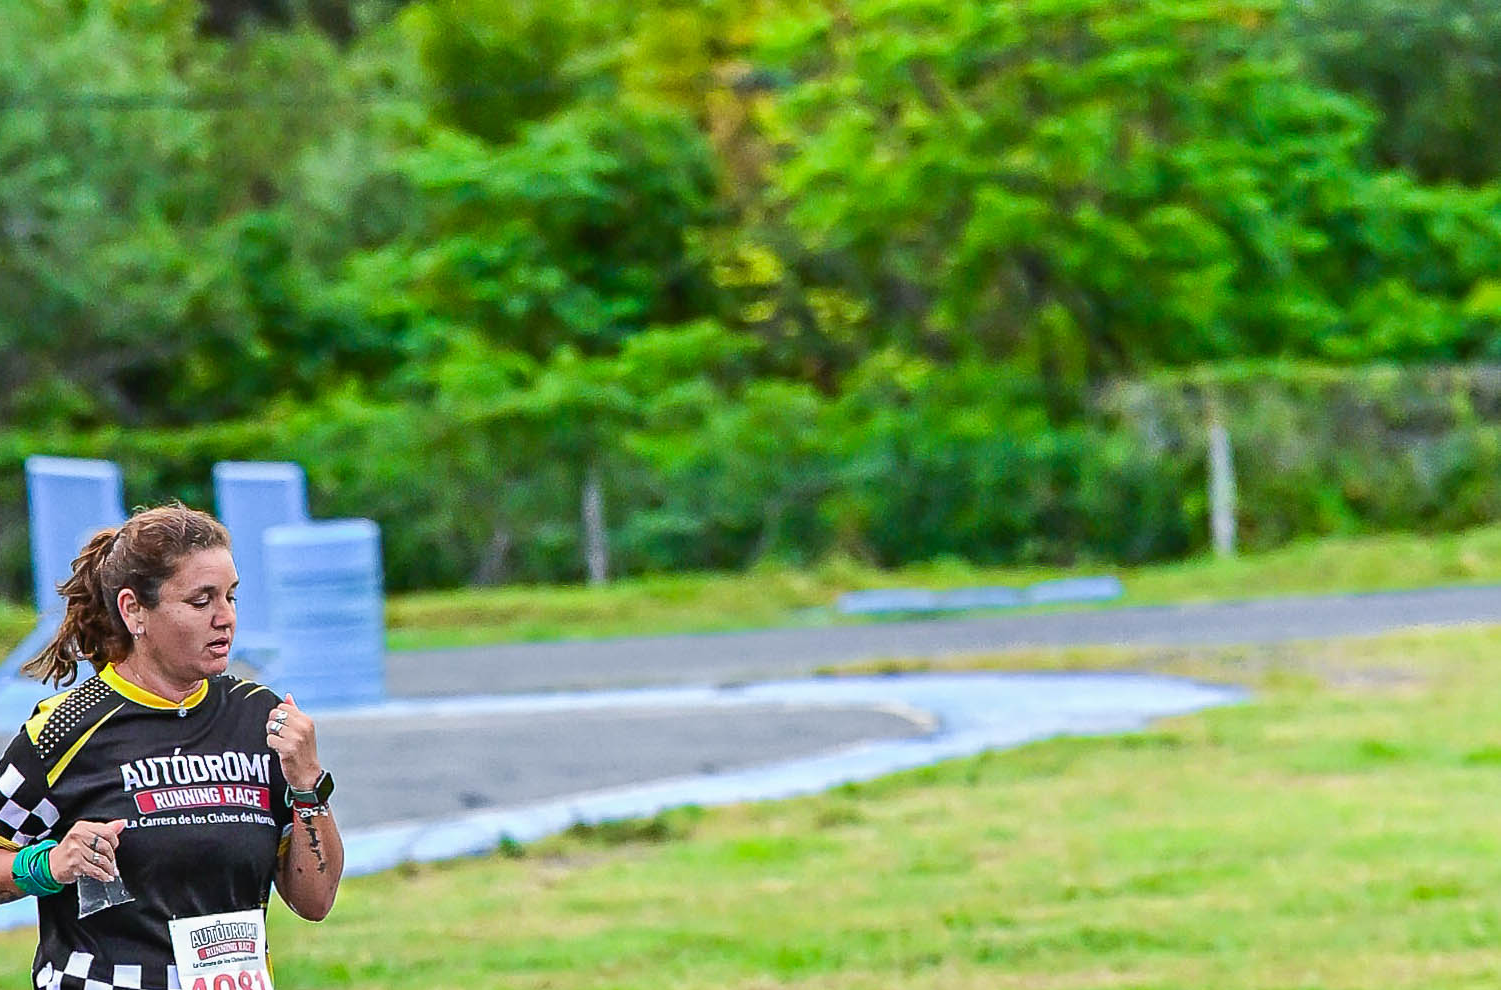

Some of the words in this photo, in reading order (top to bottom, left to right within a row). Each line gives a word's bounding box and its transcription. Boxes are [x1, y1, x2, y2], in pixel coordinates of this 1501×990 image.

[151, 787, 221, 809] RUNNING
[223, 787, 262, 808] RACE
[139, 816, 177, 827] Carrera
[178, 814, 191, 825] de
[191, 813, 206, 824] los
[207, 812, 240, 824] Clubes
[240, 812, 254, 823] del
